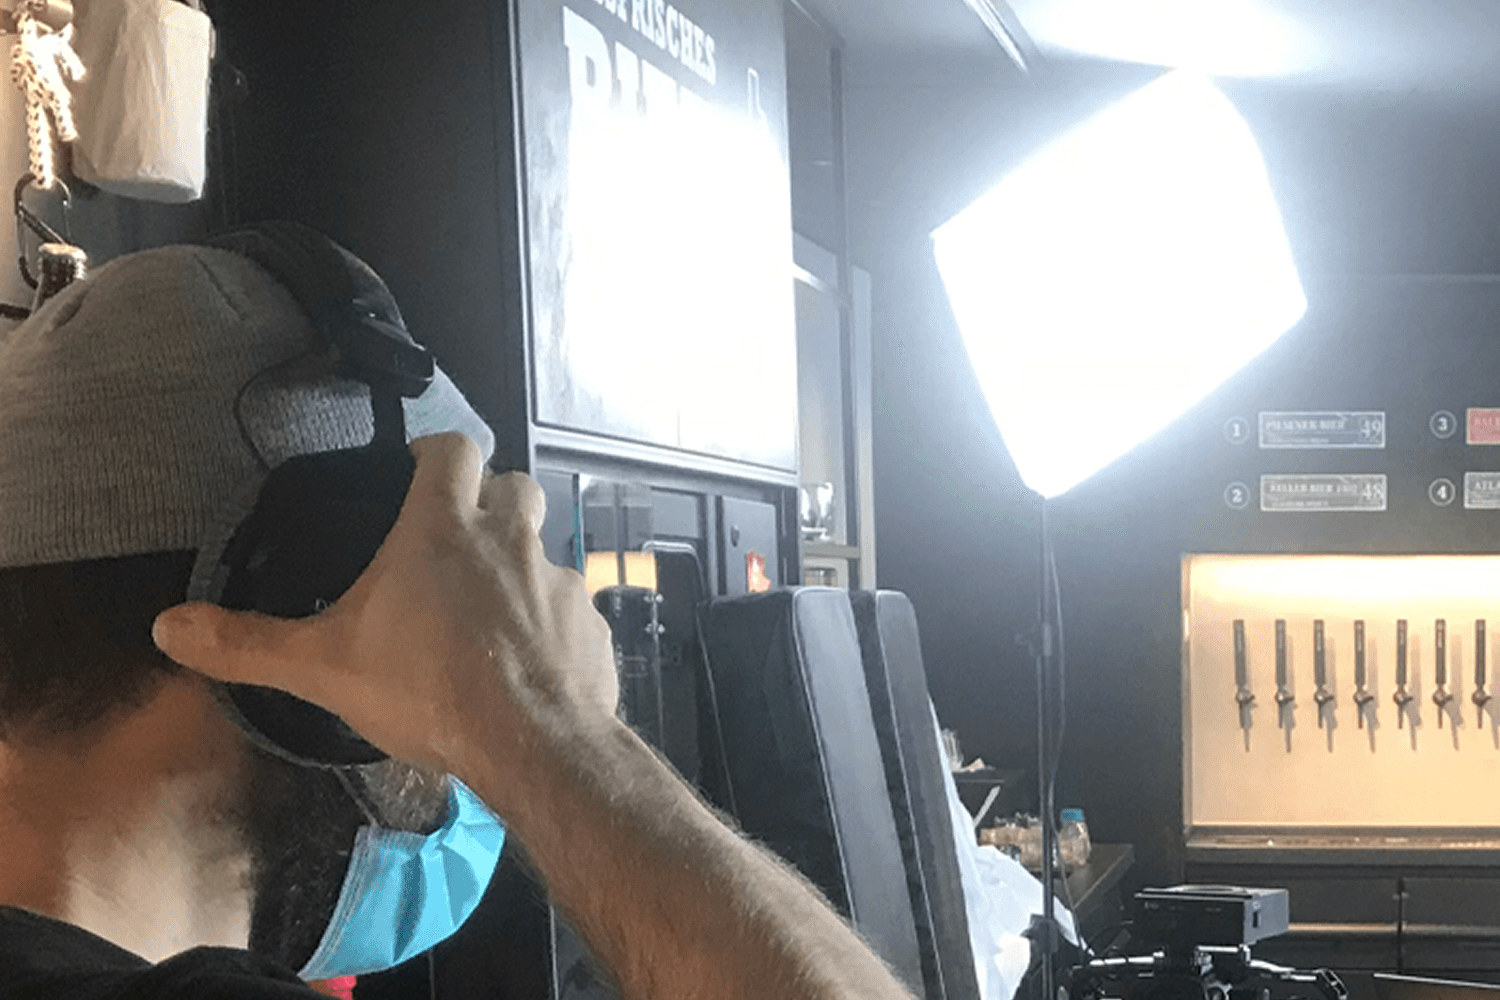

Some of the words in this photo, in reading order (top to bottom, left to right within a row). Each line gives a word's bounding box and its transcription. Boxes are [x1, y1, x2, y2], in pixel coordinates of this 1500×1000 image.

[1361, 419, 1382, 438] 49
[1438, 417, 1448, 431] 3
[1231, 488, 1243, 503] 2
[1437, 485, 1447, 499] 4
